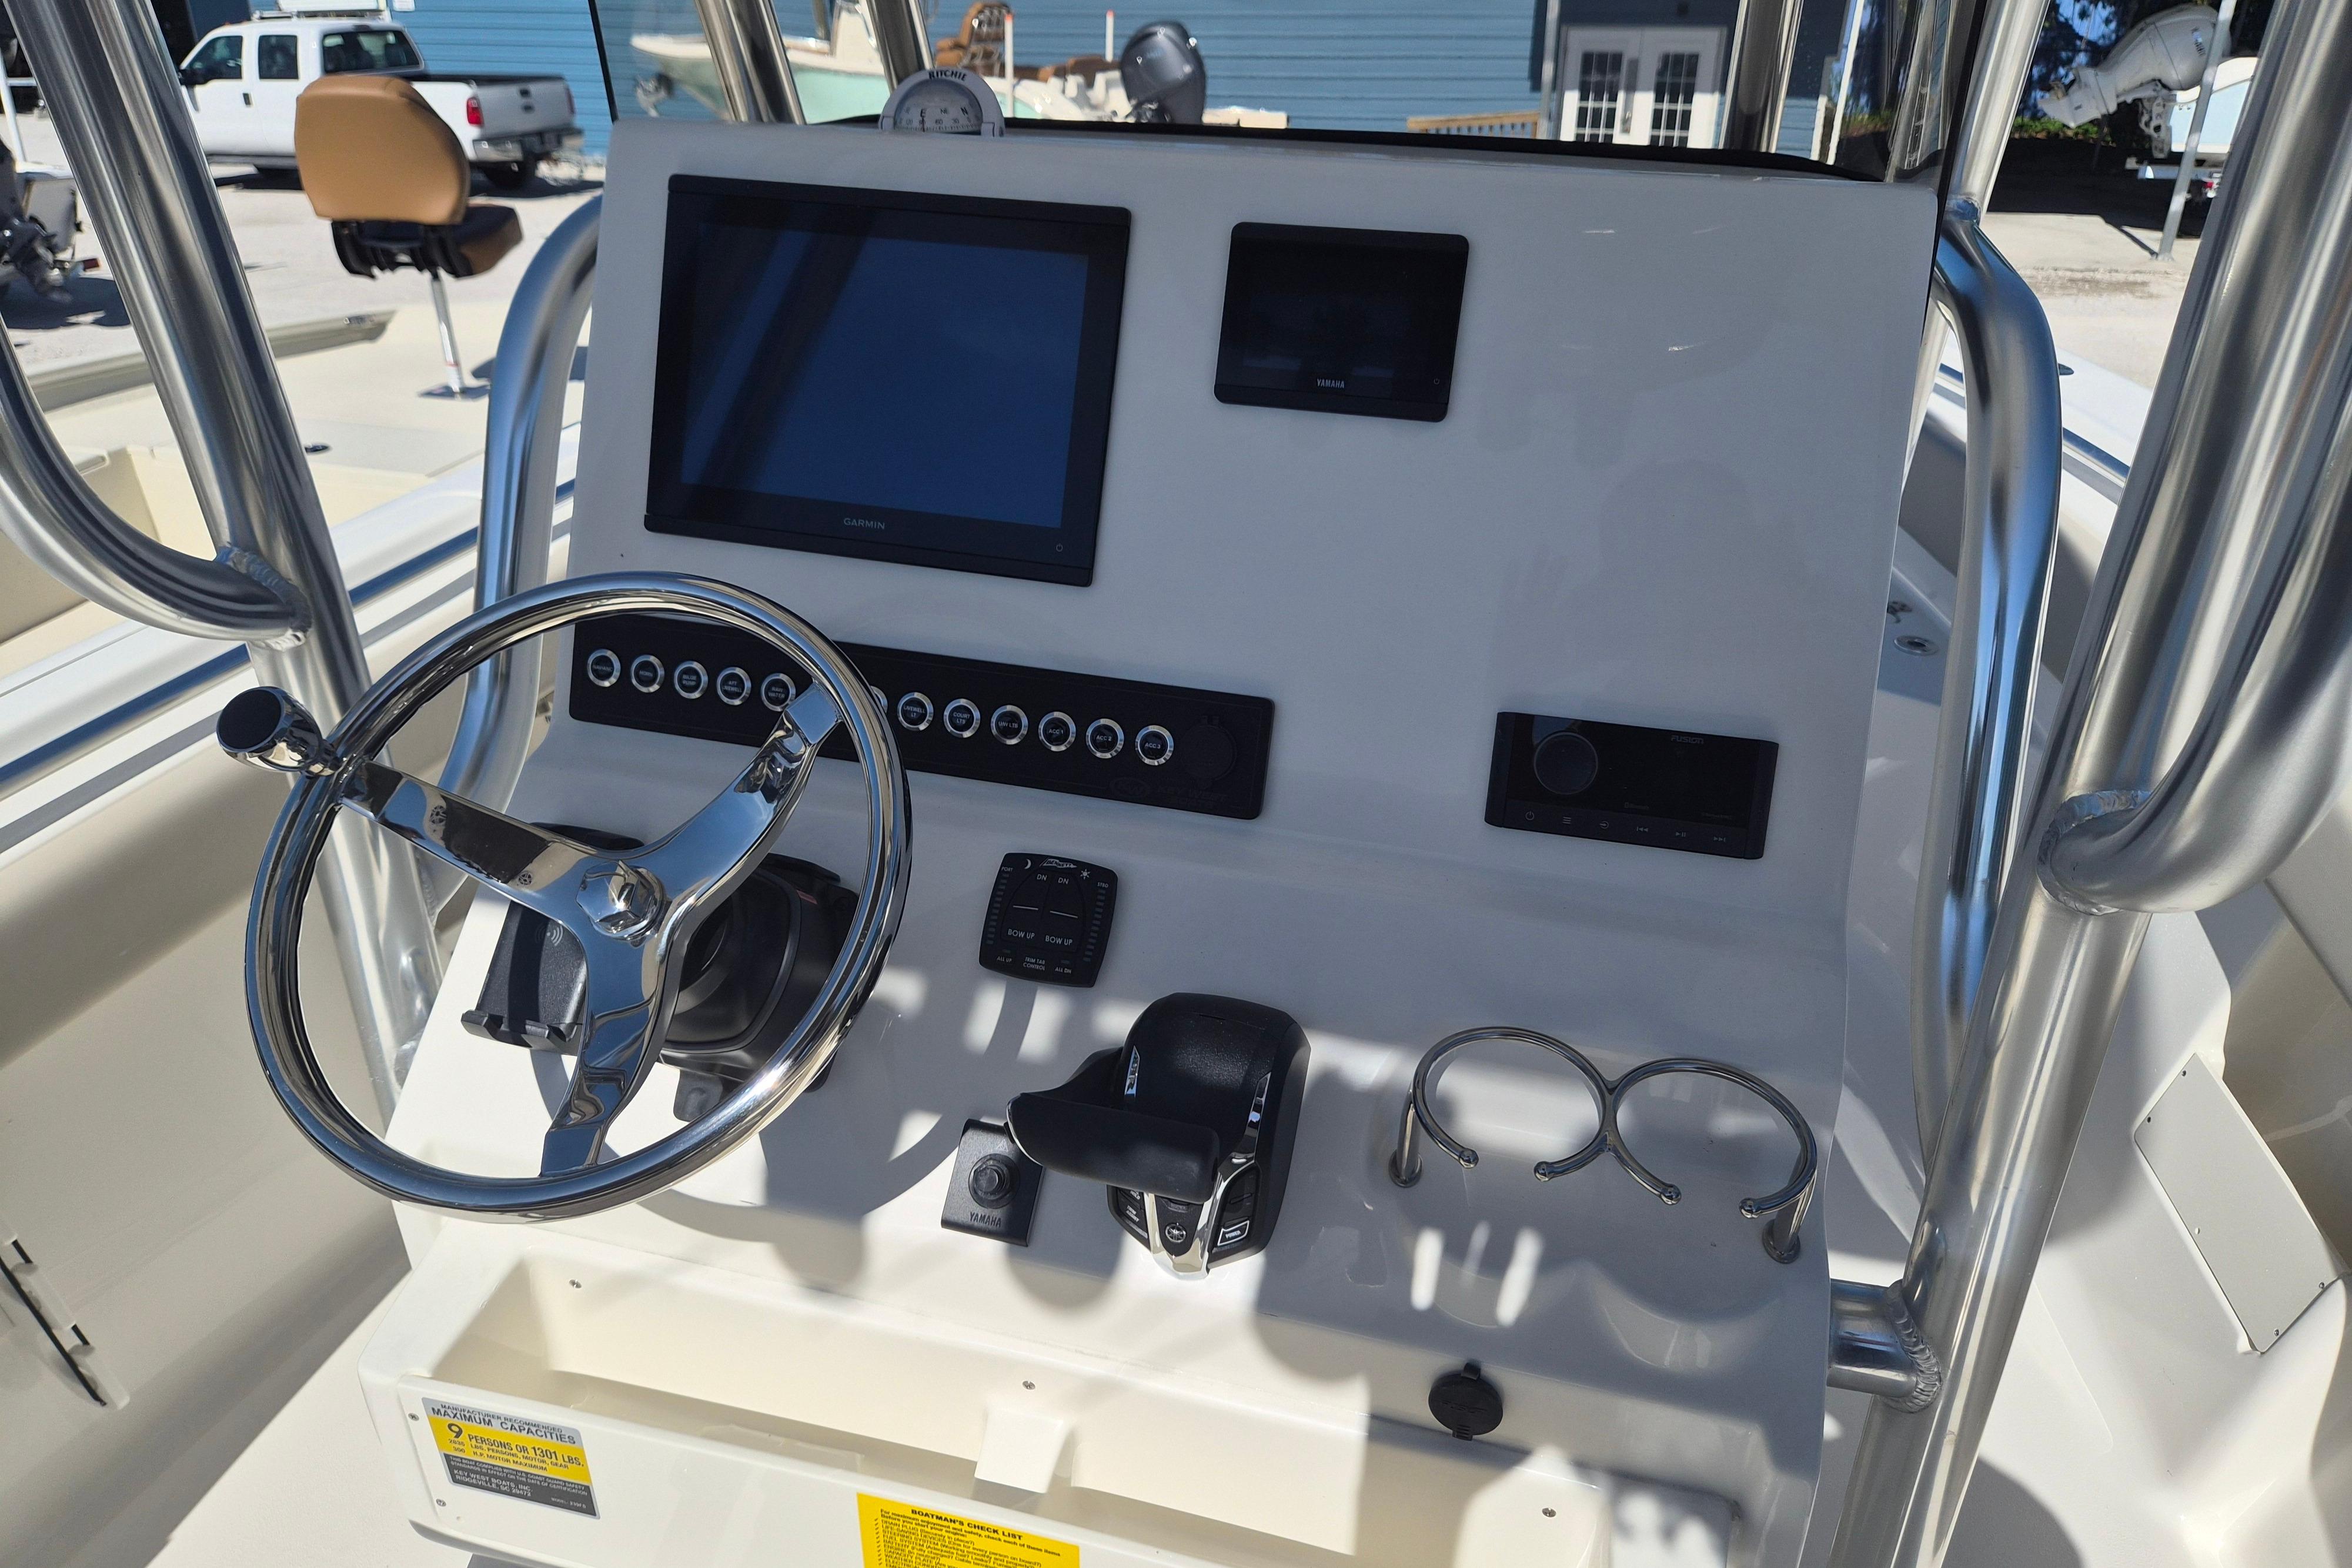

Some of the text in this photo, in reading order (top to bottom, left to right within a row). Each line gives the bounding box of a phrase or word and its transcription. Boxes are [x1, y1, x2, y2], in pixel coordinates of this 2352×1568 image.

[928, 69, 967, 81] RITCHIE
[920, 108, 927, 118] E
[960, 107, 968, 116] N
[1317, 378, 1345, 389] YAMAHA
[843, 517, 885, 530] GARMIN
[903, 706, 926, 714] LIVEWELL
[1671, 735, 1704, 744] FUSION
[1047, 859, 1073, 867] BENNETT
[1058, 877, 1069, 885] DN
[1008, 928, 1035, 940] BOW UP
[1045, 935, 1073, 946] BOW UP
[1023, 962, 1045, 971] CONTROL
[970, 1211, 1001, 1228] YAMAHA
[440, 1403, 563, 1433] MANUFACTURER RECOMMENDED
[431, 1407, 576, 1445] MAXIMUM CAPACITIES
[447, 1422, 584, 1466] 9 PERSONS OR 1301 LBS.
[486, 1453, 511, 1464] MOTOR
[512, 1458, 547, 1472] MAXIMUM
[487, 1447, 521, 1460] PERSONS,
[522, 1454, 549, 1466] MOTOR,
[550, 1460, 569, 1469] GEAR
[469, 1472, 489, 1481] WEST
[490, 1477, 517, 1488] BOATS,
[911, 1509, 1023, 1541] BOATMAN'S CHECK LIST
